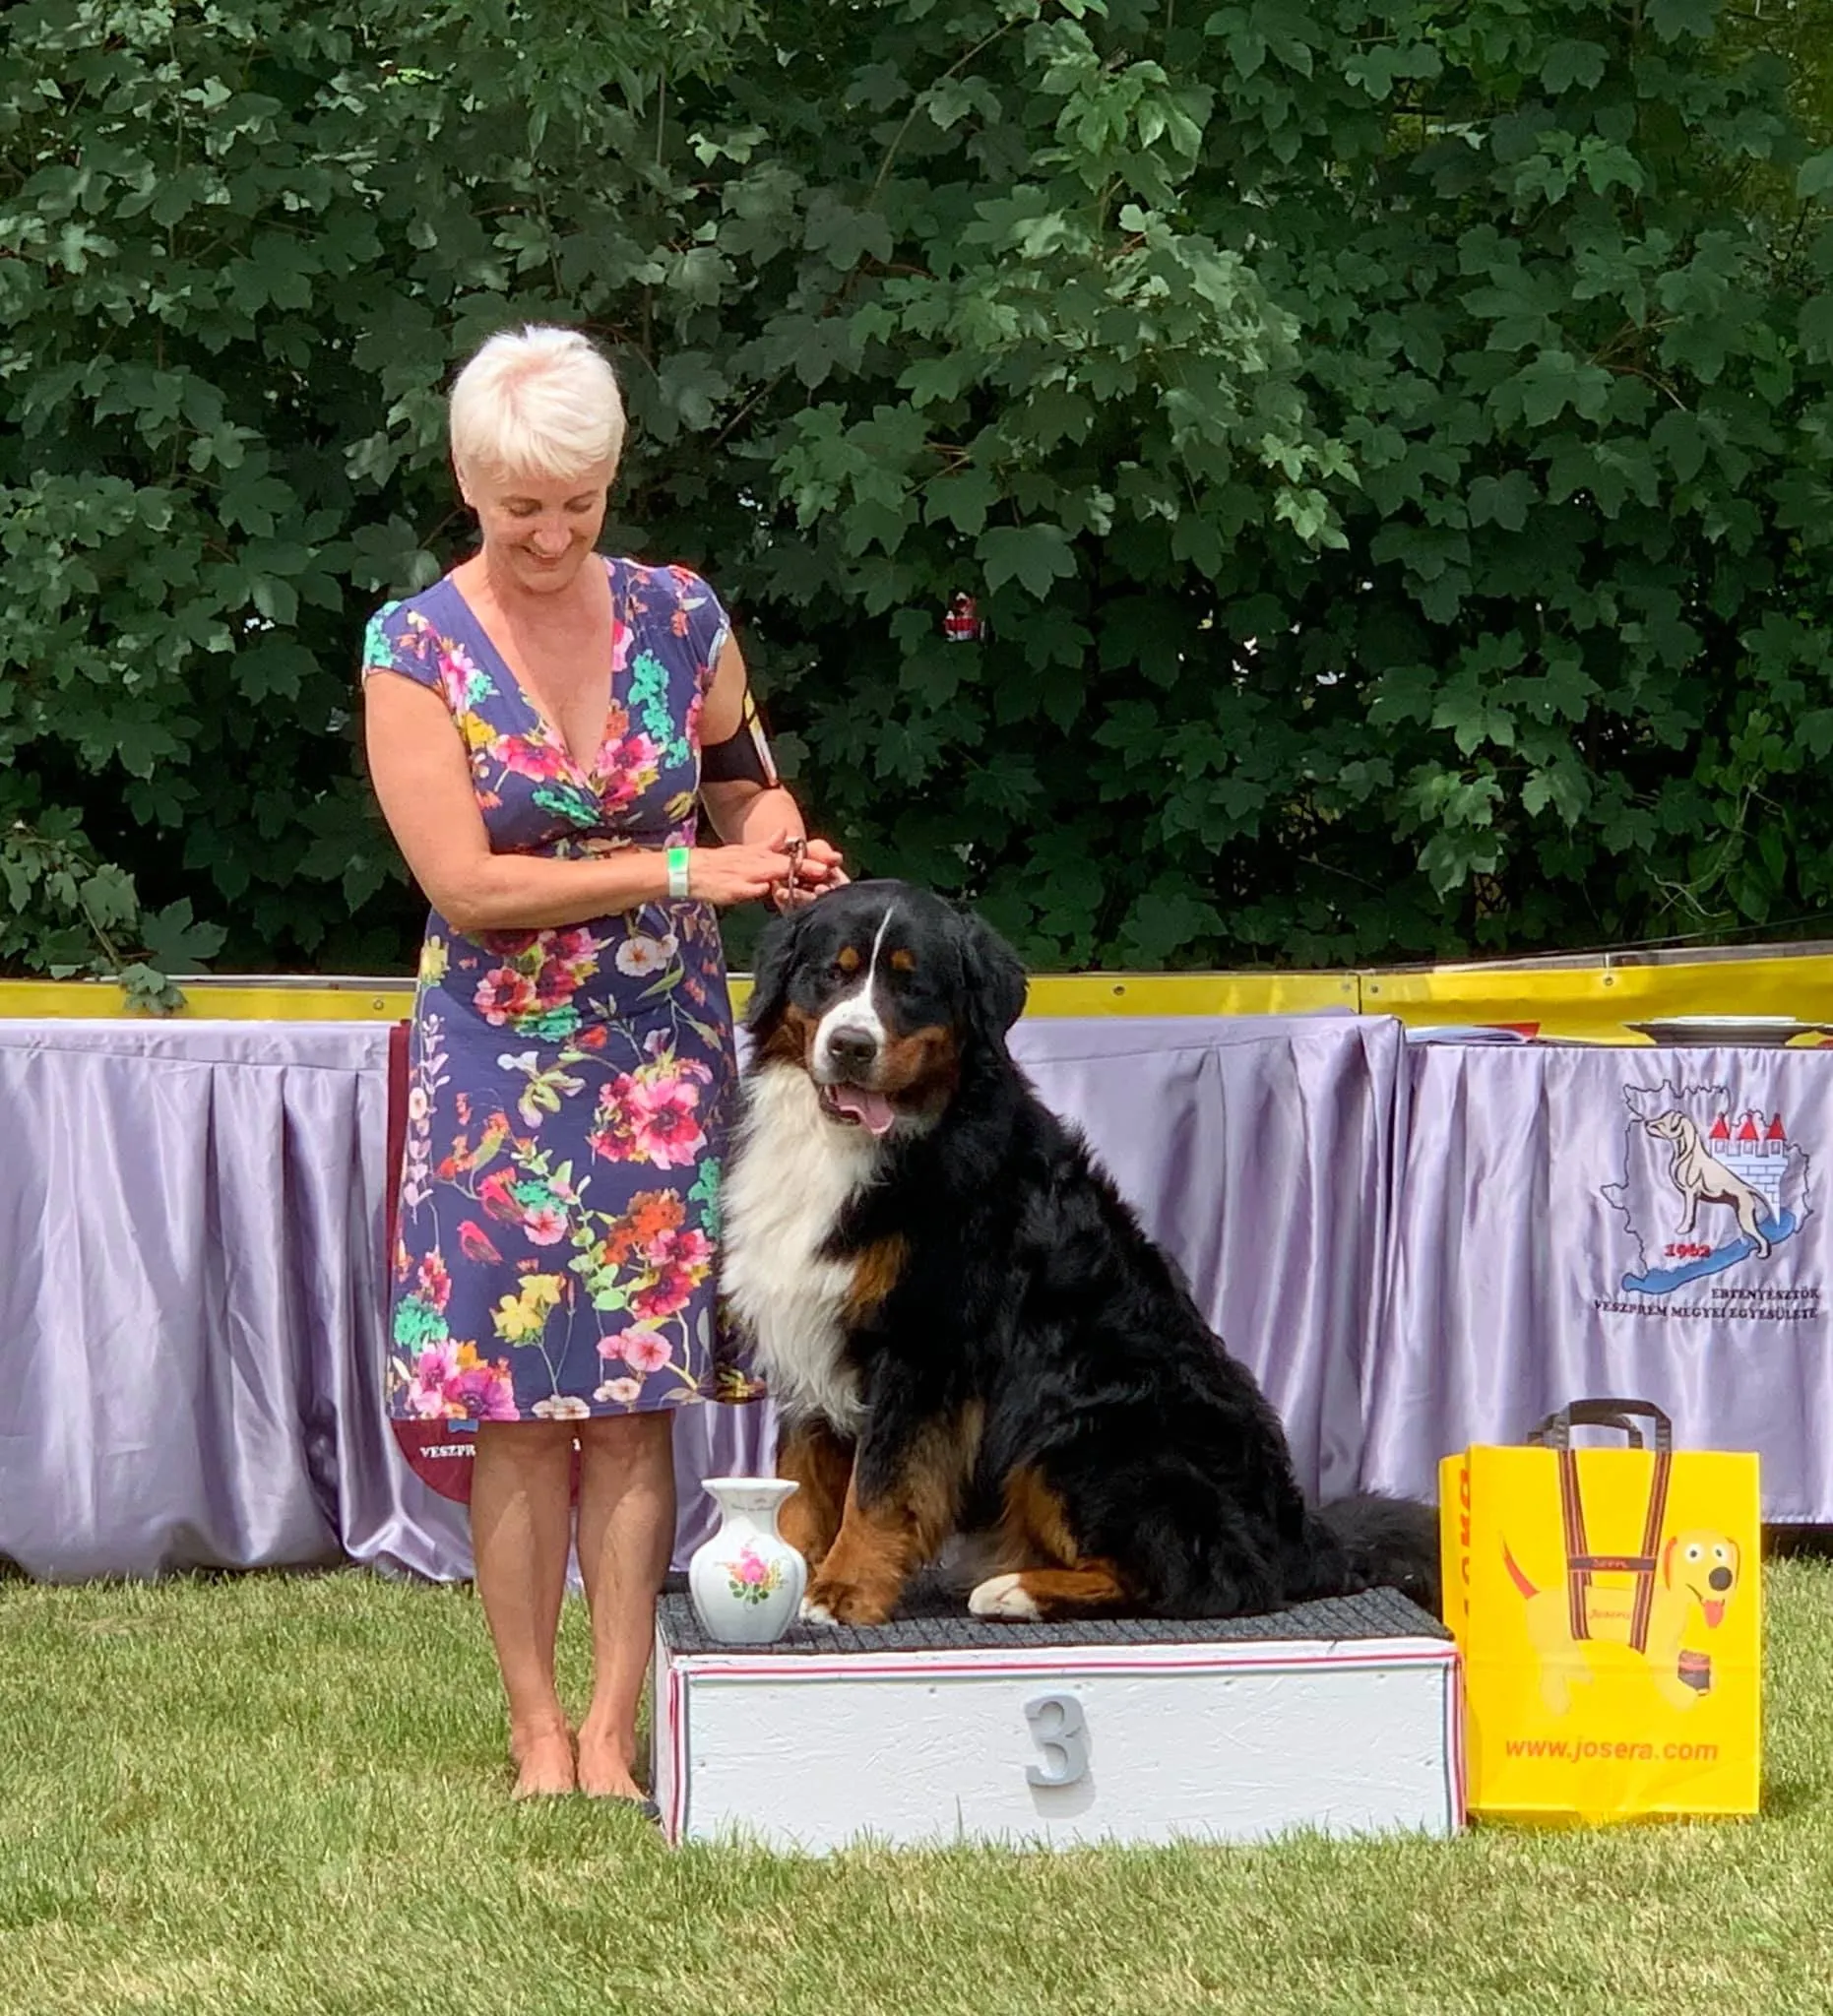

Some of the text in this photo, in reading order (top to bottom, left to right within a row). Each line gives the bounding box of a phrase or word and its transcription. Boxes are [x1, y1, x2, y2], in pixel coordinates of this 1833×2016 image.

[419, 1444, 476, 1458] VESZPR
[1025, 1695, 1087, 1785] 3
[1506, 1736, 1719, 1763] www.josera.com
